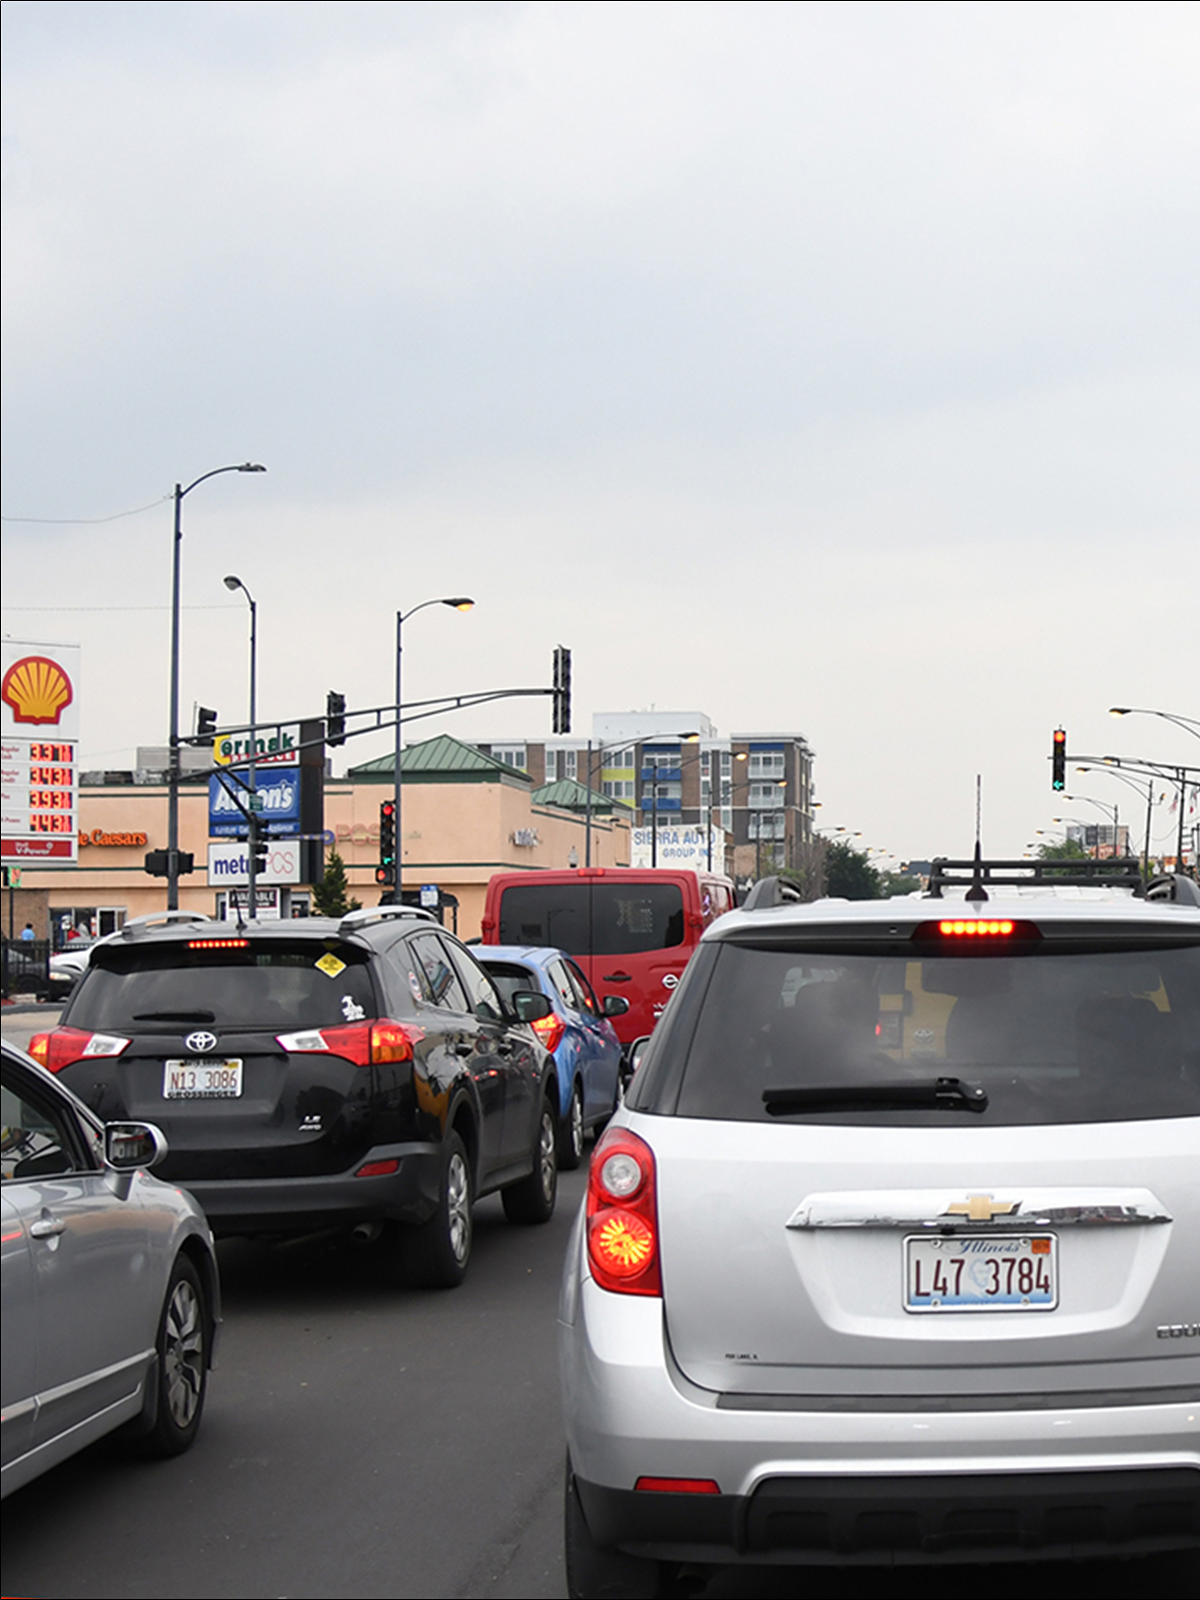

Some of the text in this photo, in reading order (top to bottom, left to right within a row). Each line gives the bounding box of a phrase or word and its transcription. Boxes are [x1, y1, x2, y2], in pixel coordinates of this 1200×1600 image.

[91, 829, 147, 845] Caesars
[662, 848, 695, 857] GROUP
[170, 1070, 237, 1090] N13 3086
[958, 1240, 1020, 1254] Illinois
[915, 1257, 1050, 1296] L47 3784
